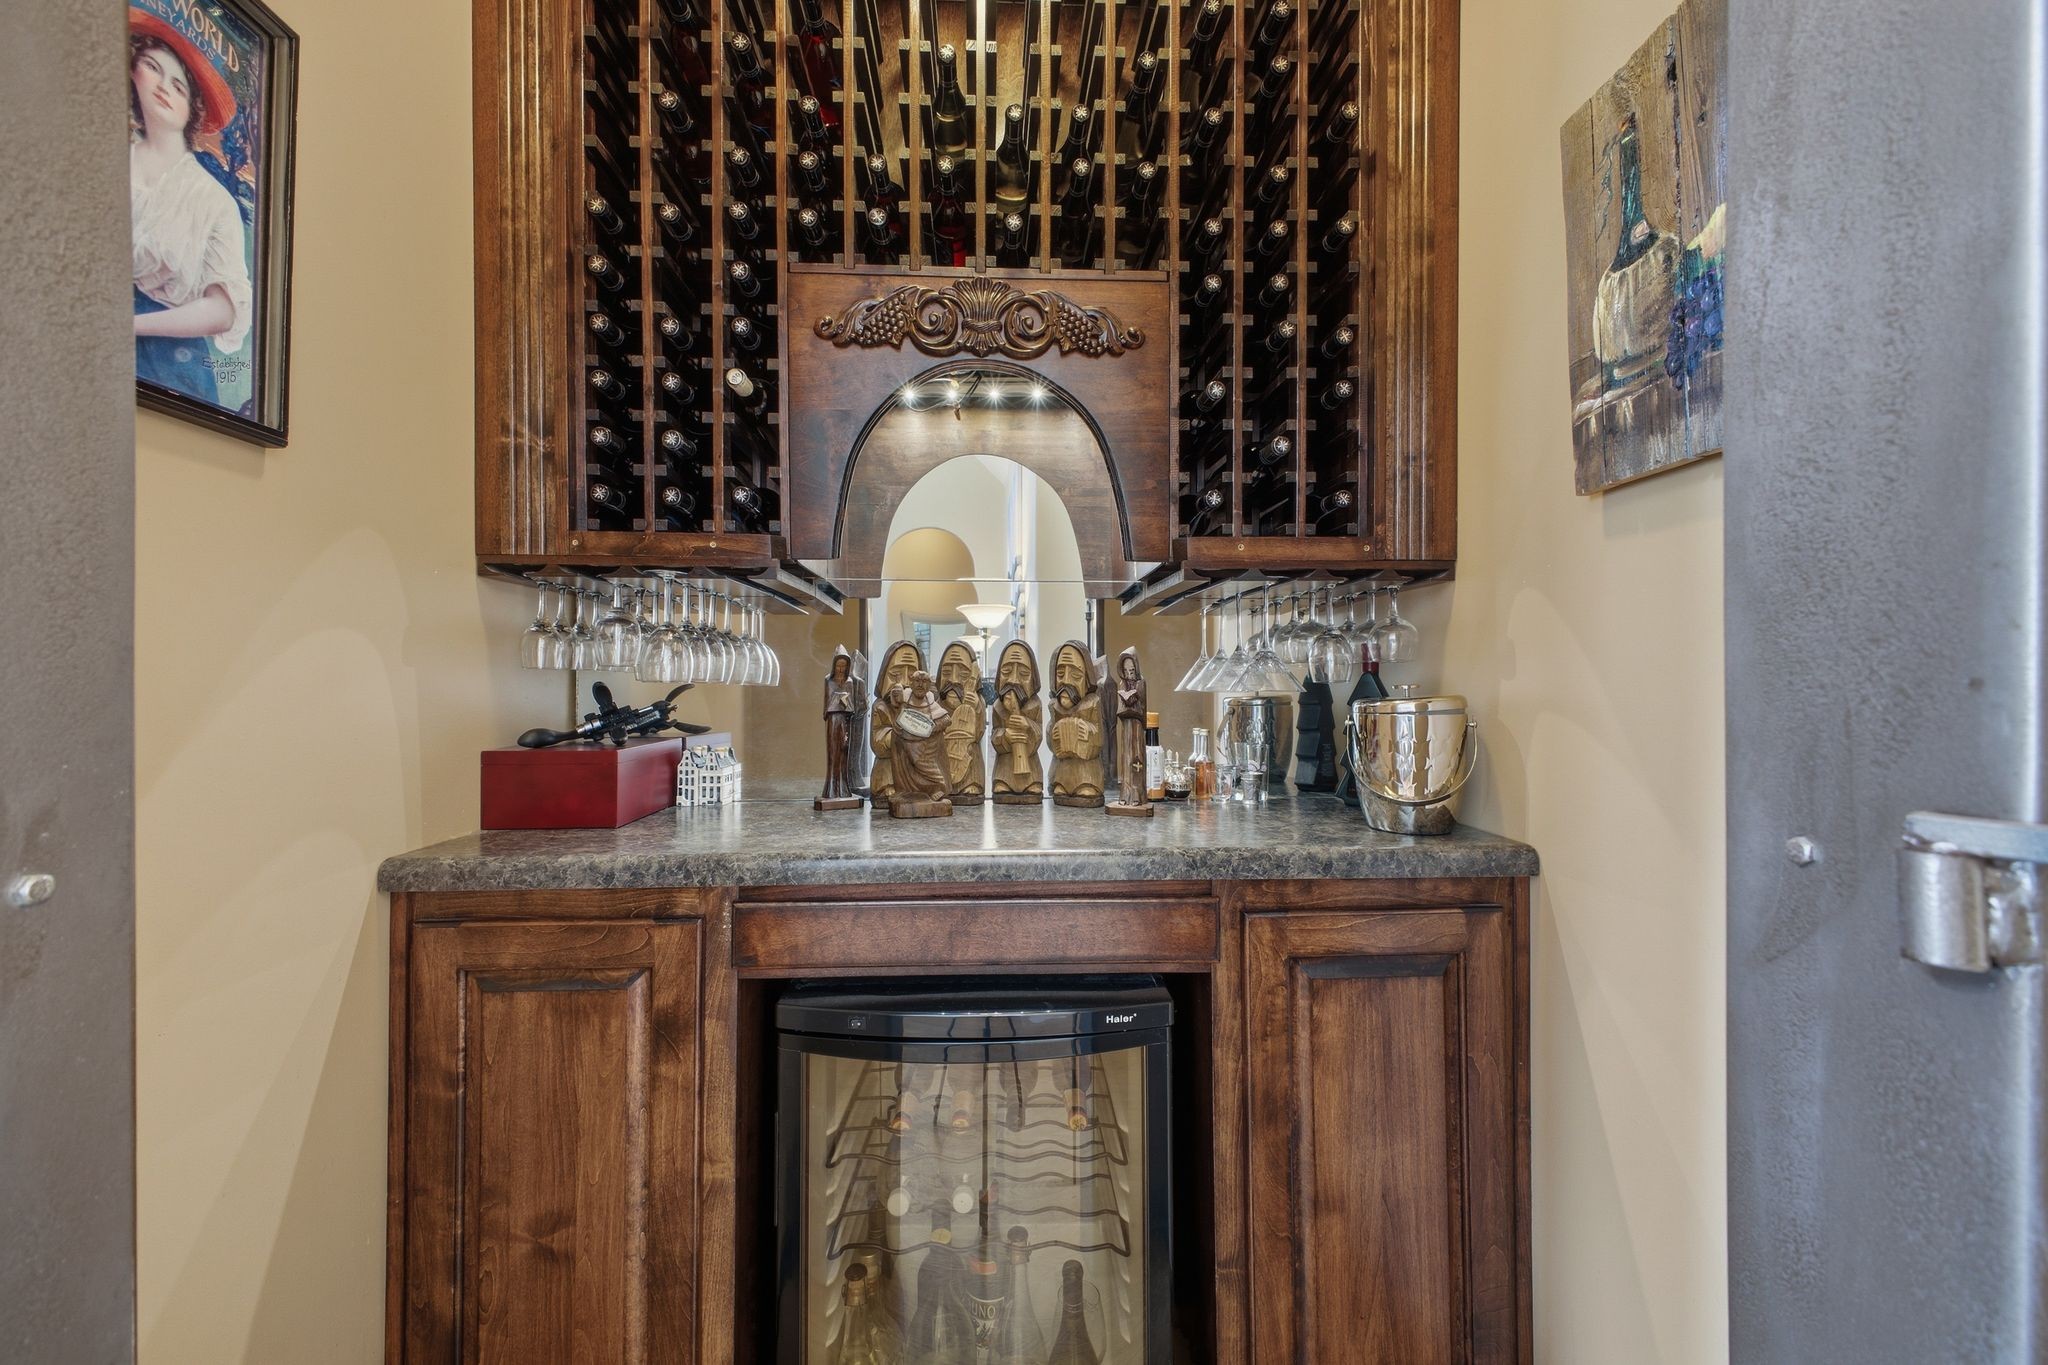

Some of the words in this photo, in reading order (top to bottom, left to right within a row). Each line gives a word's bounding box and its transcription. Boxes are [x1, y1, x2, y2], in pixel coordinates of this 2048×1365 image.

[140, 0, 216, 61] NEYARDS
[172, 0, 240, 73] WORLD
[202, 357, 251, 371] Established
[216, 370, 237, 384] 1915
[1105, 1014, 1134, 1024] Haier
